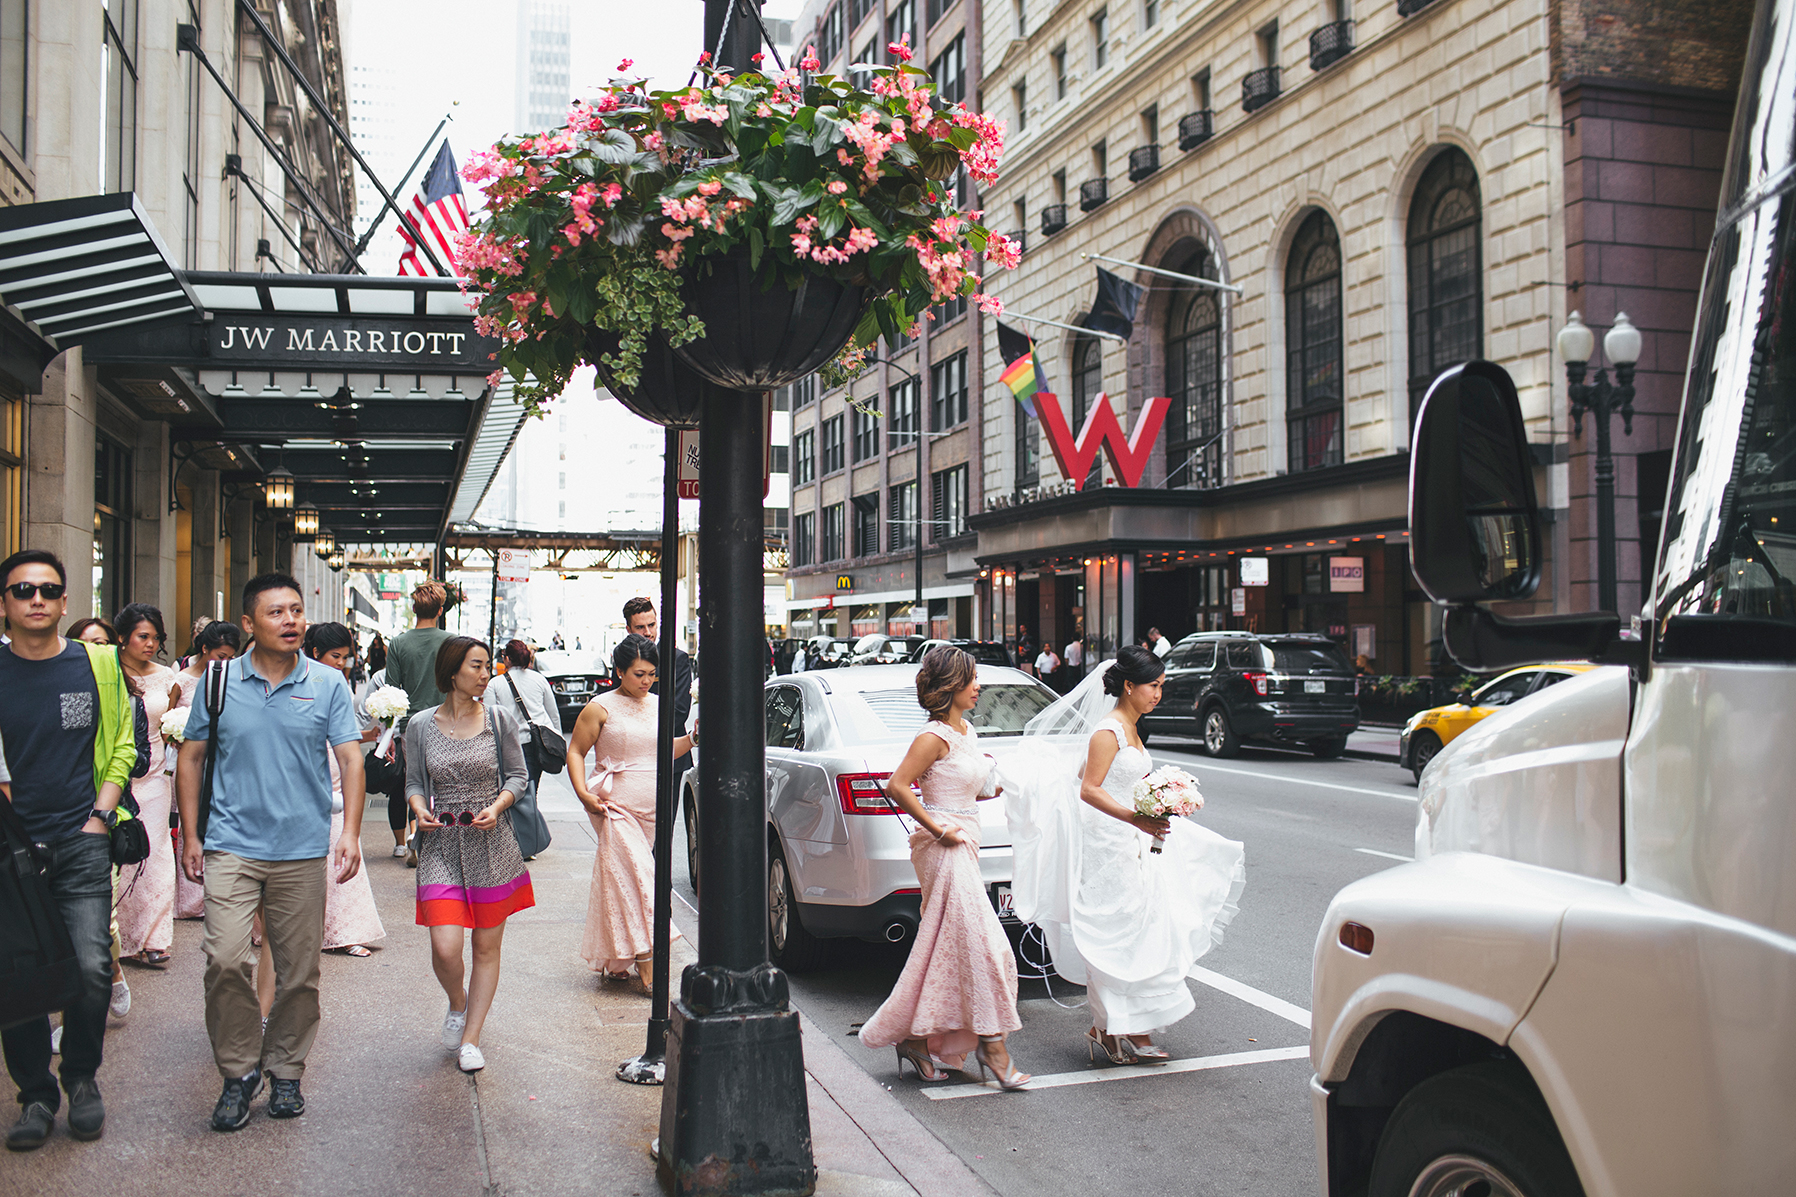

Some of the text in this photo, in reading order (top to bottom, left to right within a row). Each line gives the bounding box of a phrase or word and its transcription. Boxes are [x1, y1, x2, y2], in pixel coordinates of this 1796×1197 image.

[220, 326, 465, 355] JW MARRIOTT
[1030, 391, 1173, 492] W
[1332, 567, 1362, 578] IPO
